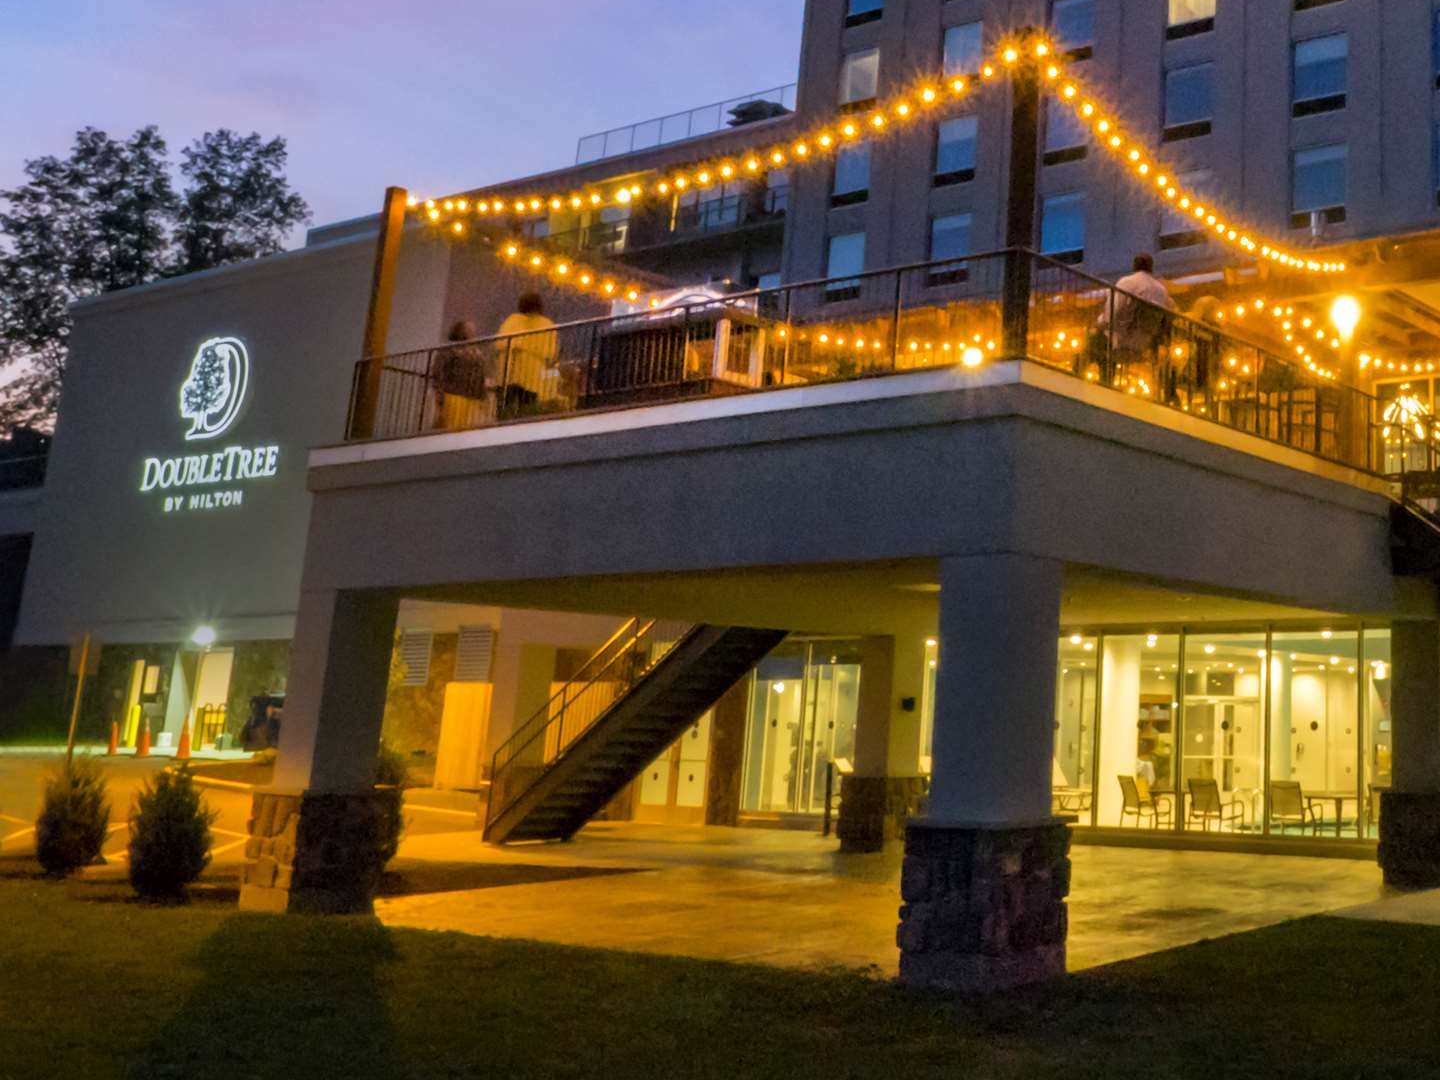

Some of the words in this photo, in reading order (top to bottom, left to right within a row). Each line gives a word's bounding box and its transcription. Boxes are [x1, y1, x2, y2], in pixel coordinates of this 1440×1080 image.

[140, 445, 279, 491] DOUBLETREE
[164, 496, 184, 512] BY
[189, 490, 243, 510] HILTON
